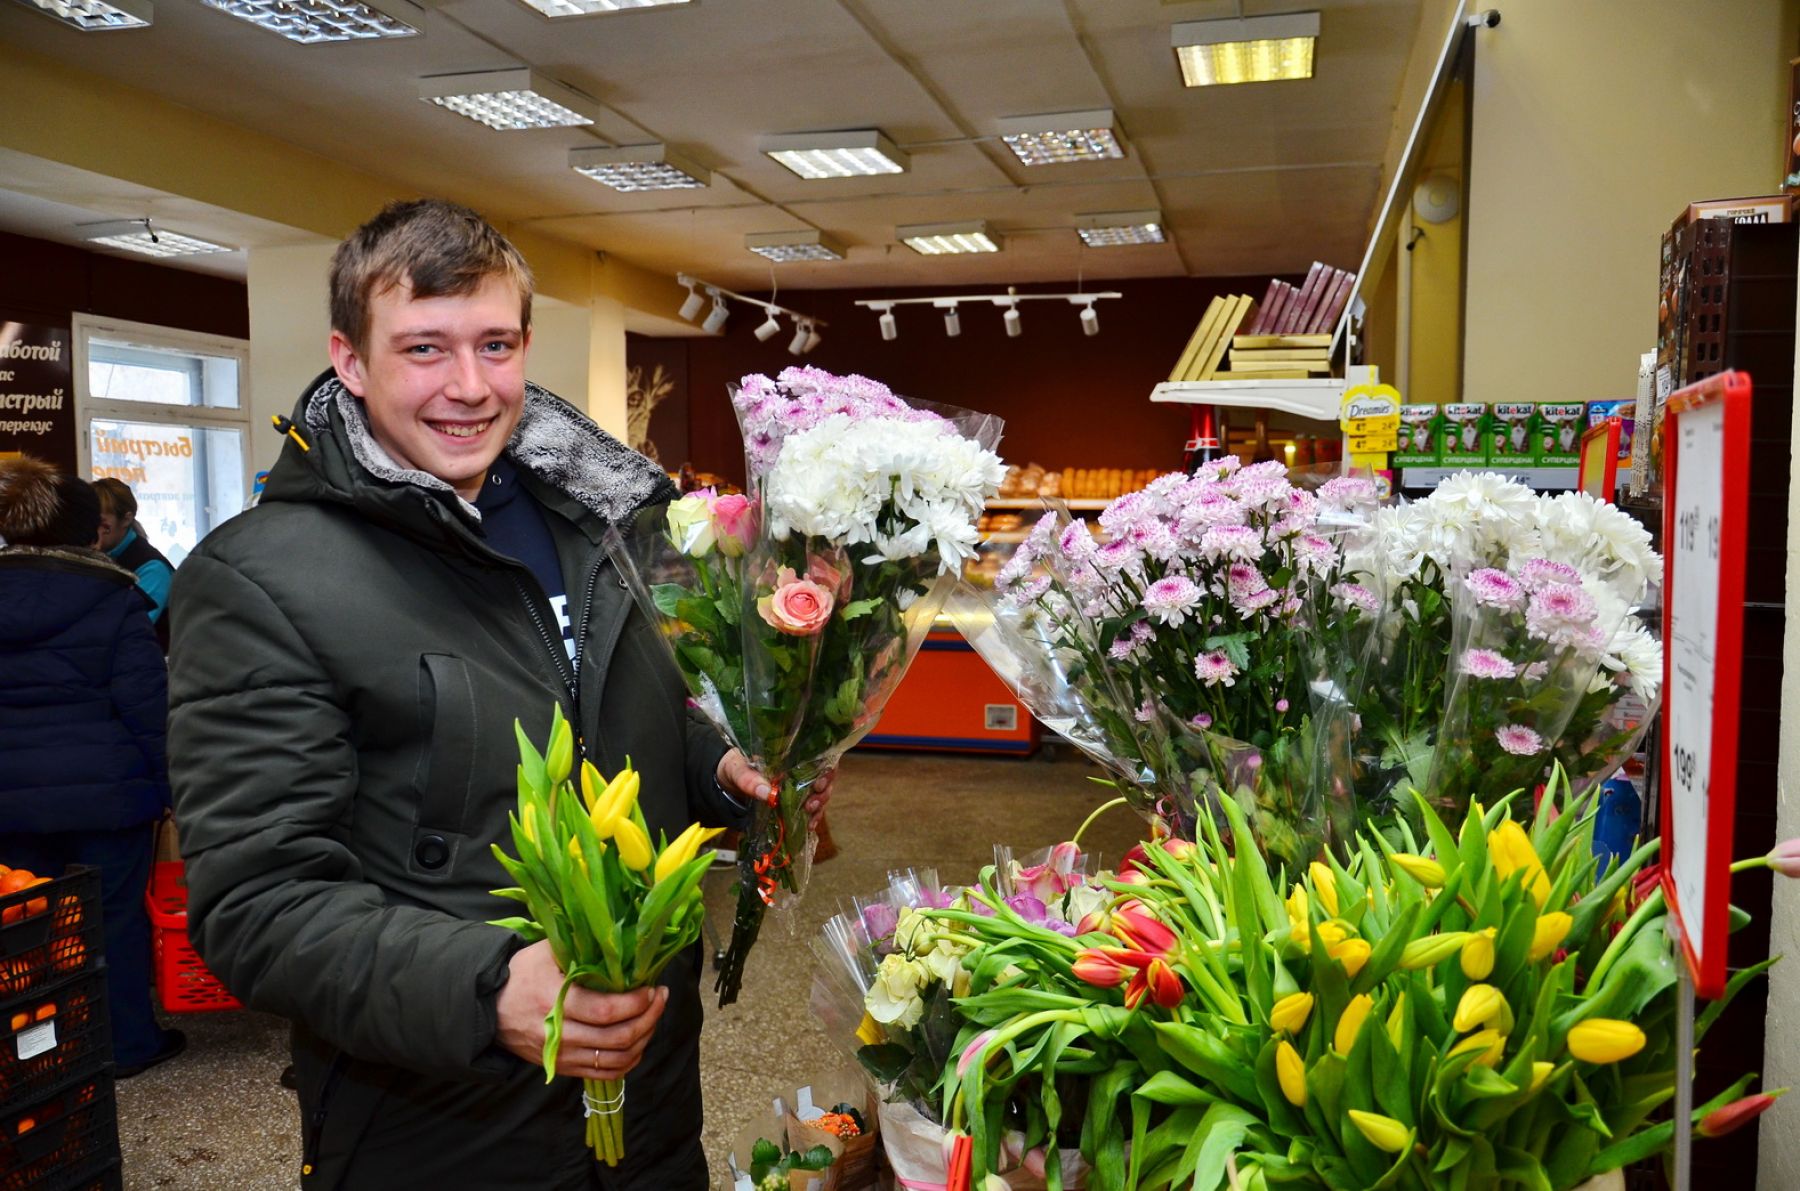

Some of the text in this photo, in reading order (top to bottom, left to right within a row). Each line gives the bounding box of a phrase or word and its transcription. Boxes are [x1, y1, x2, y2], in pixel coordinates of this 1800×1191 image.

[1350, 404, 1391, 418] Dreamies
[1497, 404, 1532, 415] kitekat
[1545, 406, 1580, 417] kitekat
[0, 420, 53, 436] перекус
